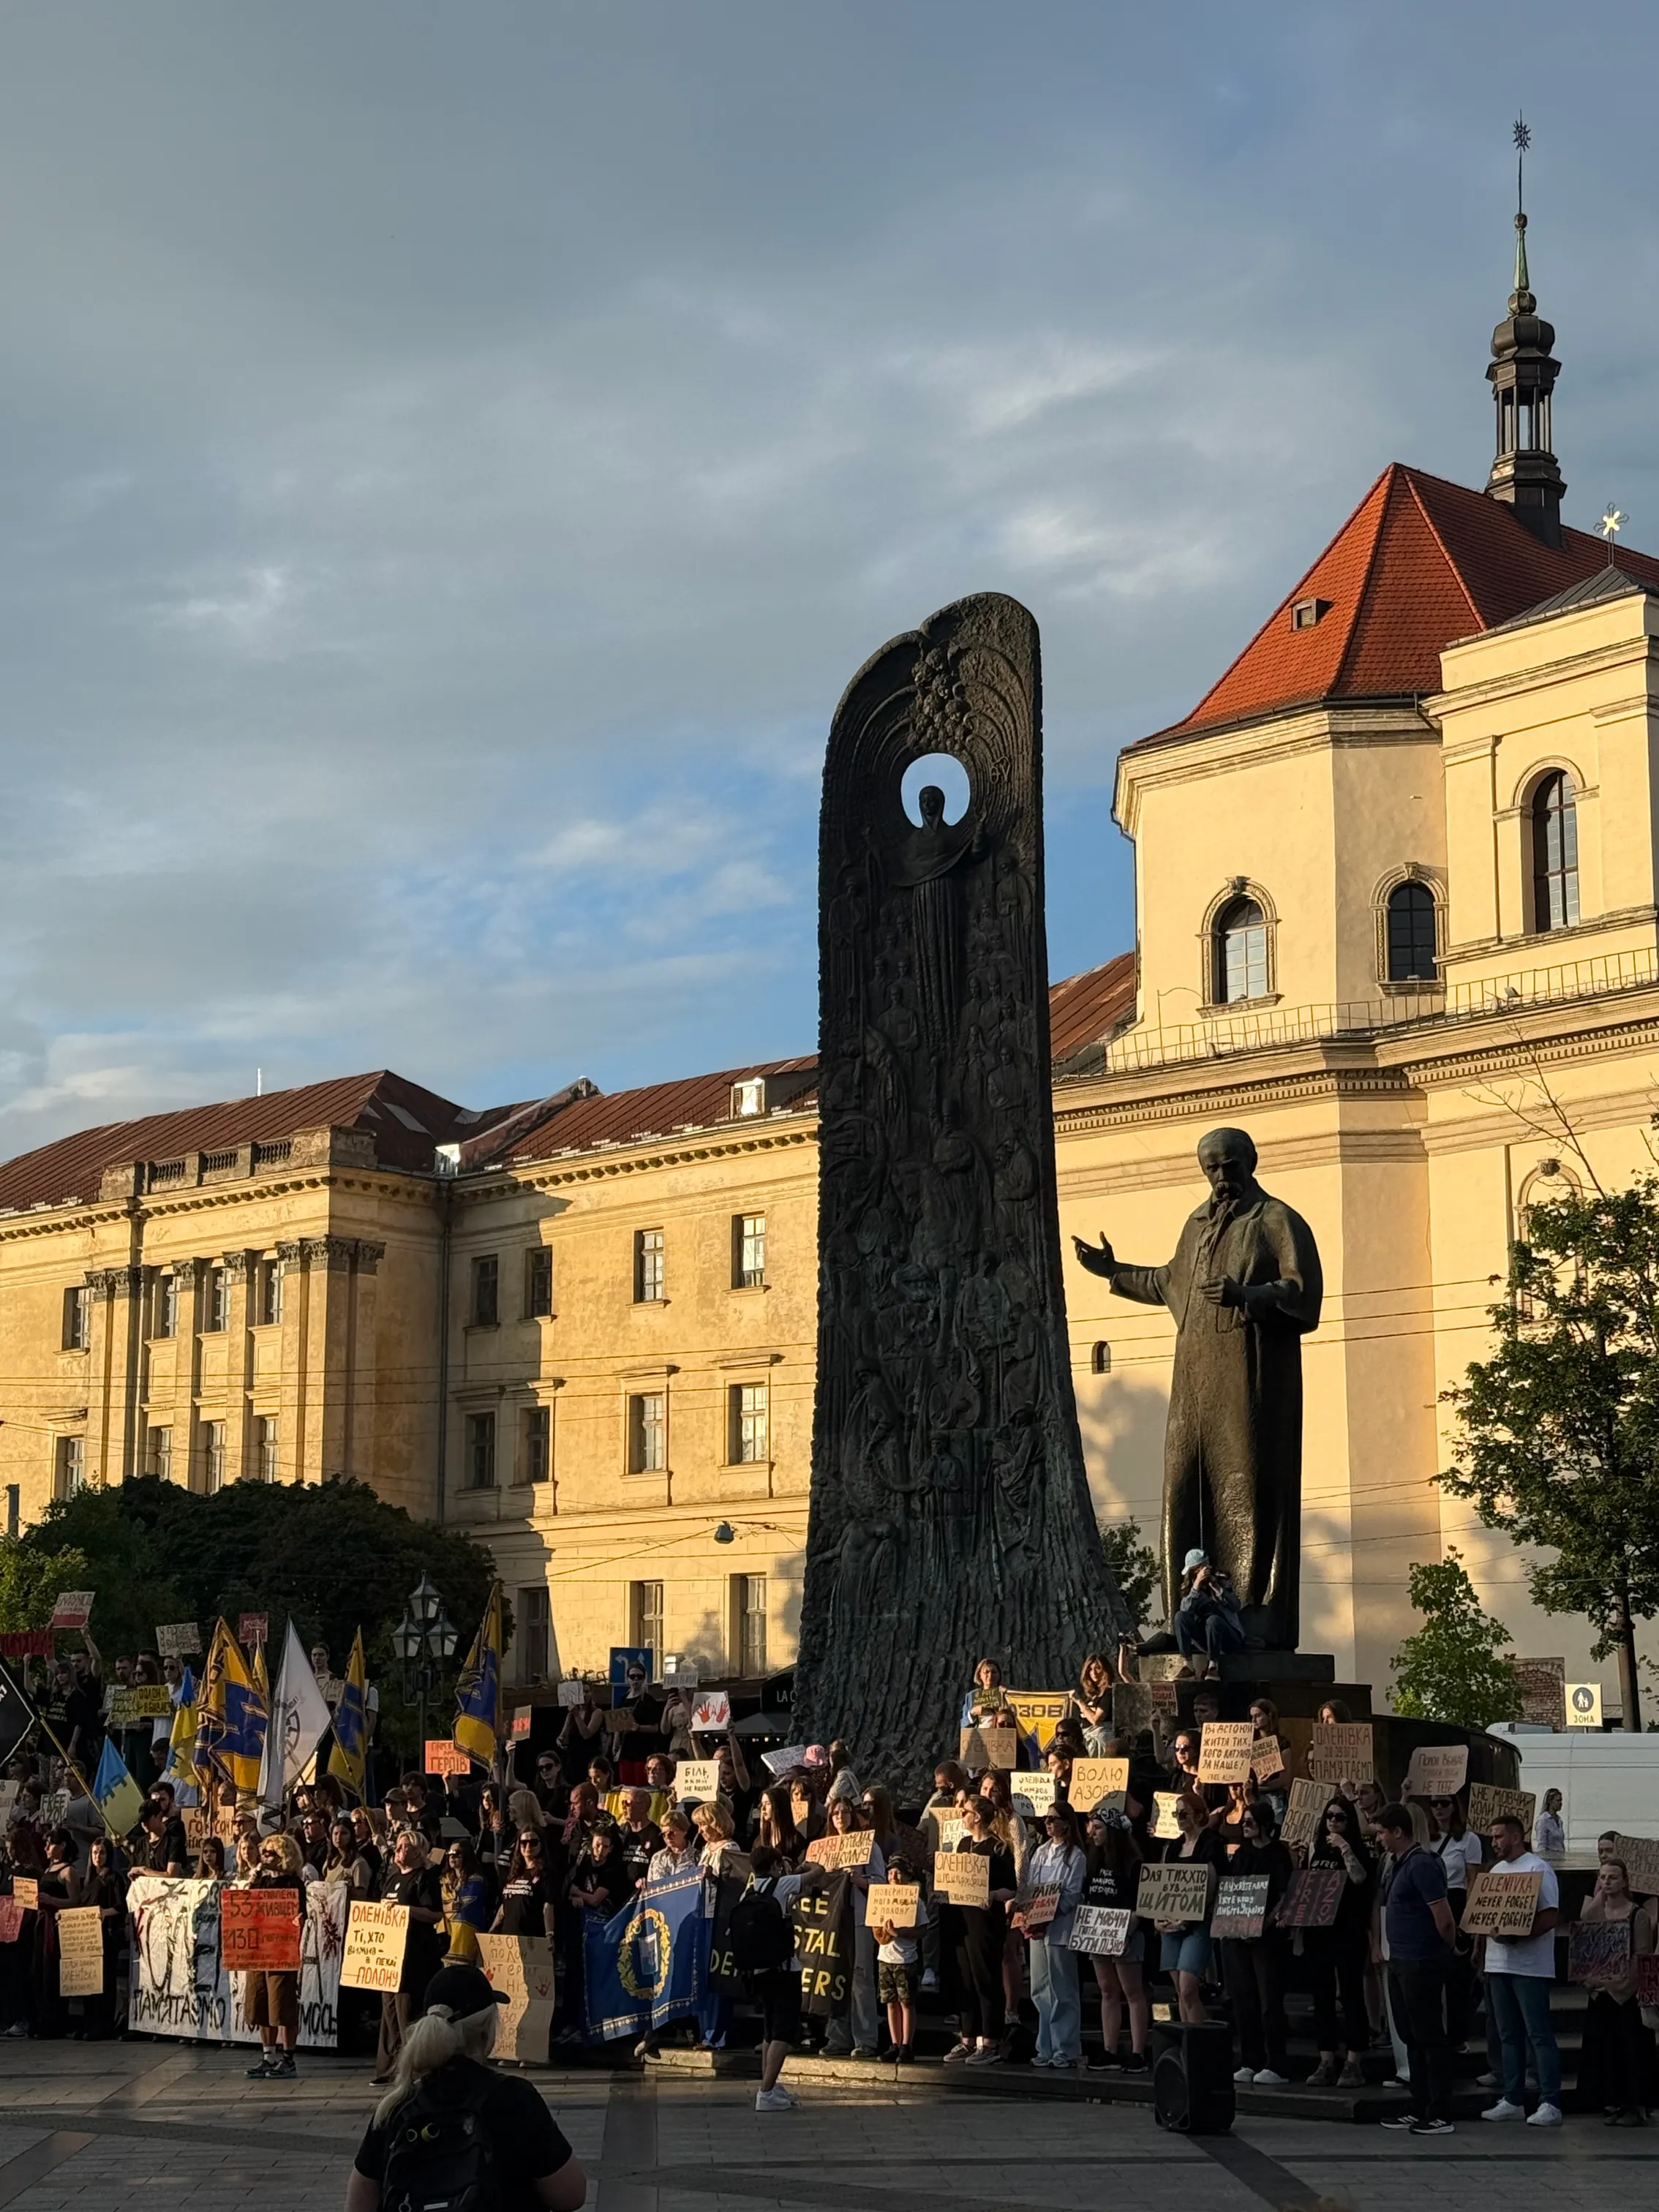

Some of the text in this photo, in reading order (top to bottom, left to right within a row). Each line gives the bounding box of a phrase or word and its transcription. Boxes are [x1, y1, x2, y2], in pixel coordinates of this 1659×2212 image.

[777, 1690, 788, 1703] LA
[1017, 1704, 1064, 1718] ЗОВ
[1573, 1715, 1595, 1723] ЗОНА
[1203, 1737, 1230, 1747] ЖИТТЯ
[1317, 1727, 1370, 1745] ОЛЕНІВКА
[1203, 1749, 1222, 1758] КОГО
[1202, 1760, 1244, 1770] ЗА НАШЕ!
[1077, 1766, 1123, 1782] ВОЛЮ
[1019, 1786, 1047, 1794] СИМВОЛ
[1074, 1785, 1121, 1800] АЗОВУ
[1290, 1780, 1333, 1810] ПОЛОН
[1423, 1780, 1434, 1794] НЕ
[42, 1794, 67, 1811] FREE
[1476, 1786, 1527, 1806] НЕ МОВЧИ
[1470, 1800, 1495, 1817] КОЛИ
[1140, 1866, 1162, 1882] ДЛЯ
[1032, 1882, 1062, 1899] РАЇНА
[1162, 1883, 1180, 1892] БУВ
[1481, 1876, 1533, 1894] OLENIVKA
[230, 1892, 252, 1918] 53
[1138, 1892, 1204, 1914] ЩИТОМ
[1475, 1895, 1502, 1908] NEVER
[353, 1905, 406, 1927] ОЛЕНІВКА
[881, 1907, 910, 1915] ПОЛОНУ
[1075, 1906, 1094, 1925] НЕ
[1094, 1909, 1129, 1929] МОВЧИ
[1468, 1911, 1533, 1928] NEVER FORGIVE
[228, 1927, 260, 1949] 130
[367, 1931, 385, 1944] ХТО
[794, 1925, 840, 1957] STAL
[1070, 1936, 1099, 1952] БУТИ
[710, 1949, 738, 1978] DE
[356, 1966, 399, 1987] ПОЛОНУ
